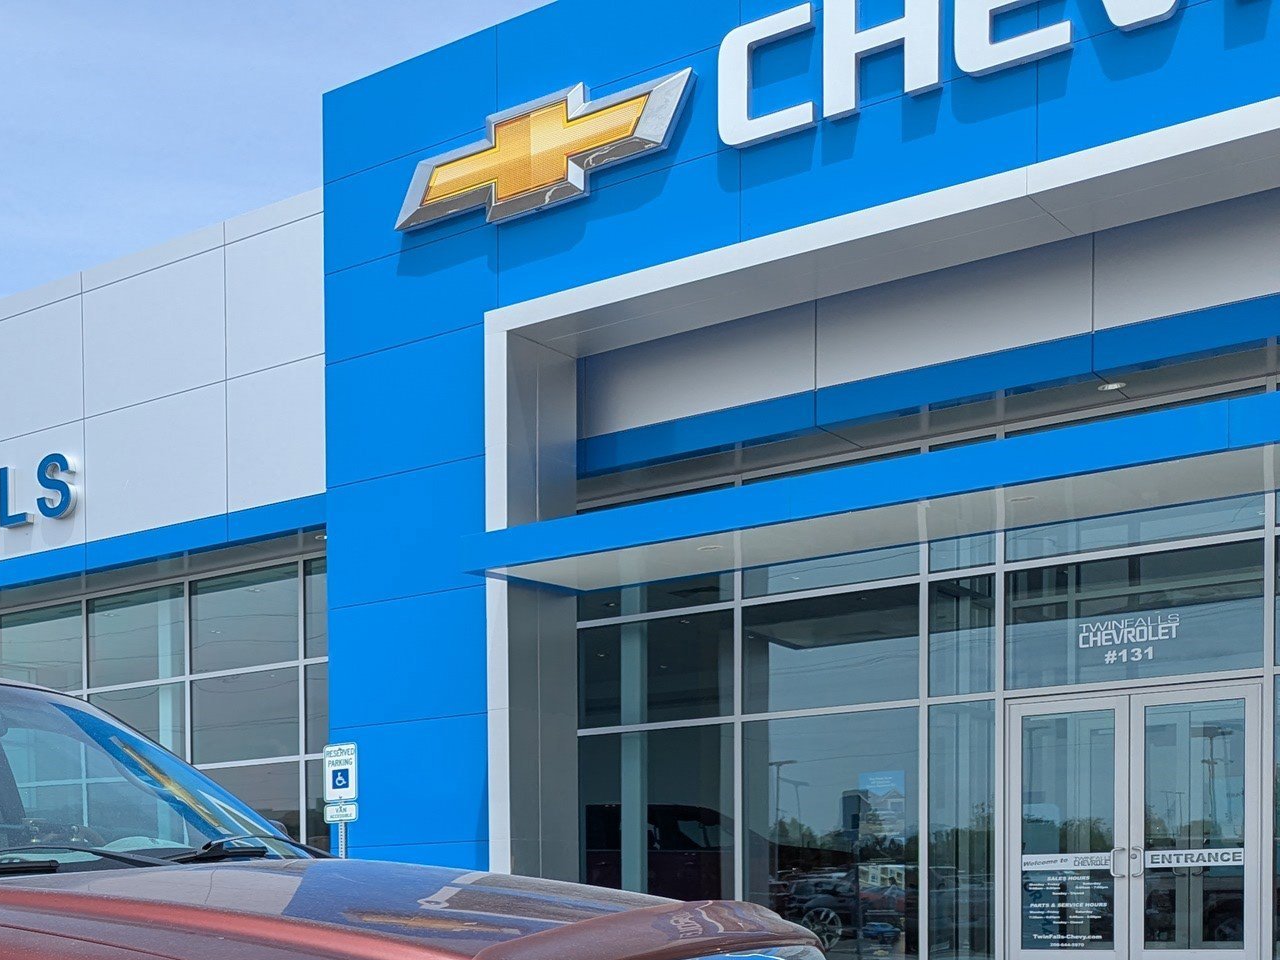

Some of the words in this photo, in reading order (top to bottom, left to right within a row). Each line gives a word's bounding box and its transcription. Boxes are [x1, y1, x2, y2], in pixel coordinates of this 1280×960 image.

[718, 0, 1176, 149] CHE
[1079, 613, 1179, 633] TWINFALLS
[1079, 623, 1179, 648] CHEVROLET
[1104, 646, 1154, 664] #131
[326, 748, 355, 758] RESERVED
[328, 758, 352, 767] PARKING
[1023, 858, 1059, 867] Welcome
[1073, 859, 1110, 867] CHEVROLE
[1150, 851, 1243, 865] ENTRANCE
